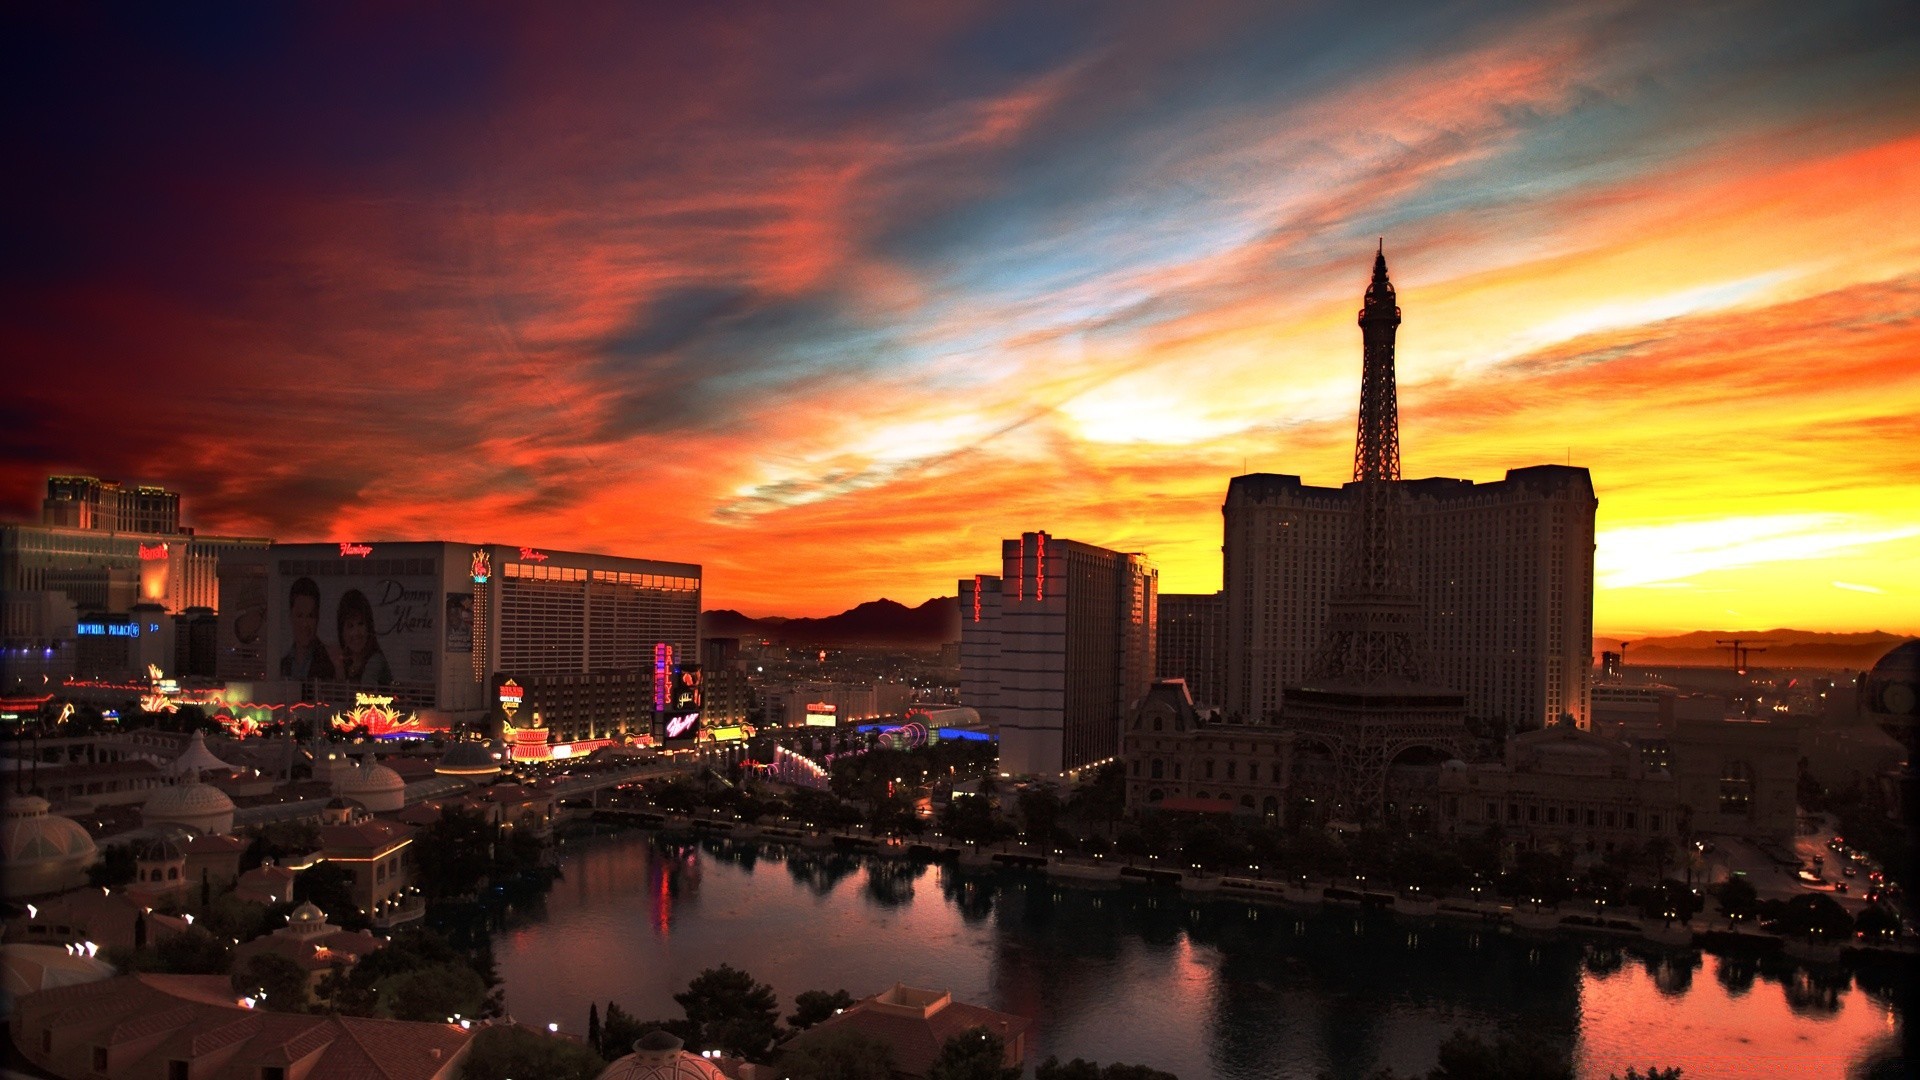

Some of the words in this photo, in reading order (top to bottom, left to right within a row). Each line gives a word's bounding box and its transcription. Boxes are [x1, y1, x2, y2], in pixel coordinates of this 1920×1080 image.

[340, 542, 373, 558] Flamingo
[376, 580, 434, 607] Donny
[77, 624, 106, 635] IMPERIAL
[375, 606, 433, 636] Marie
